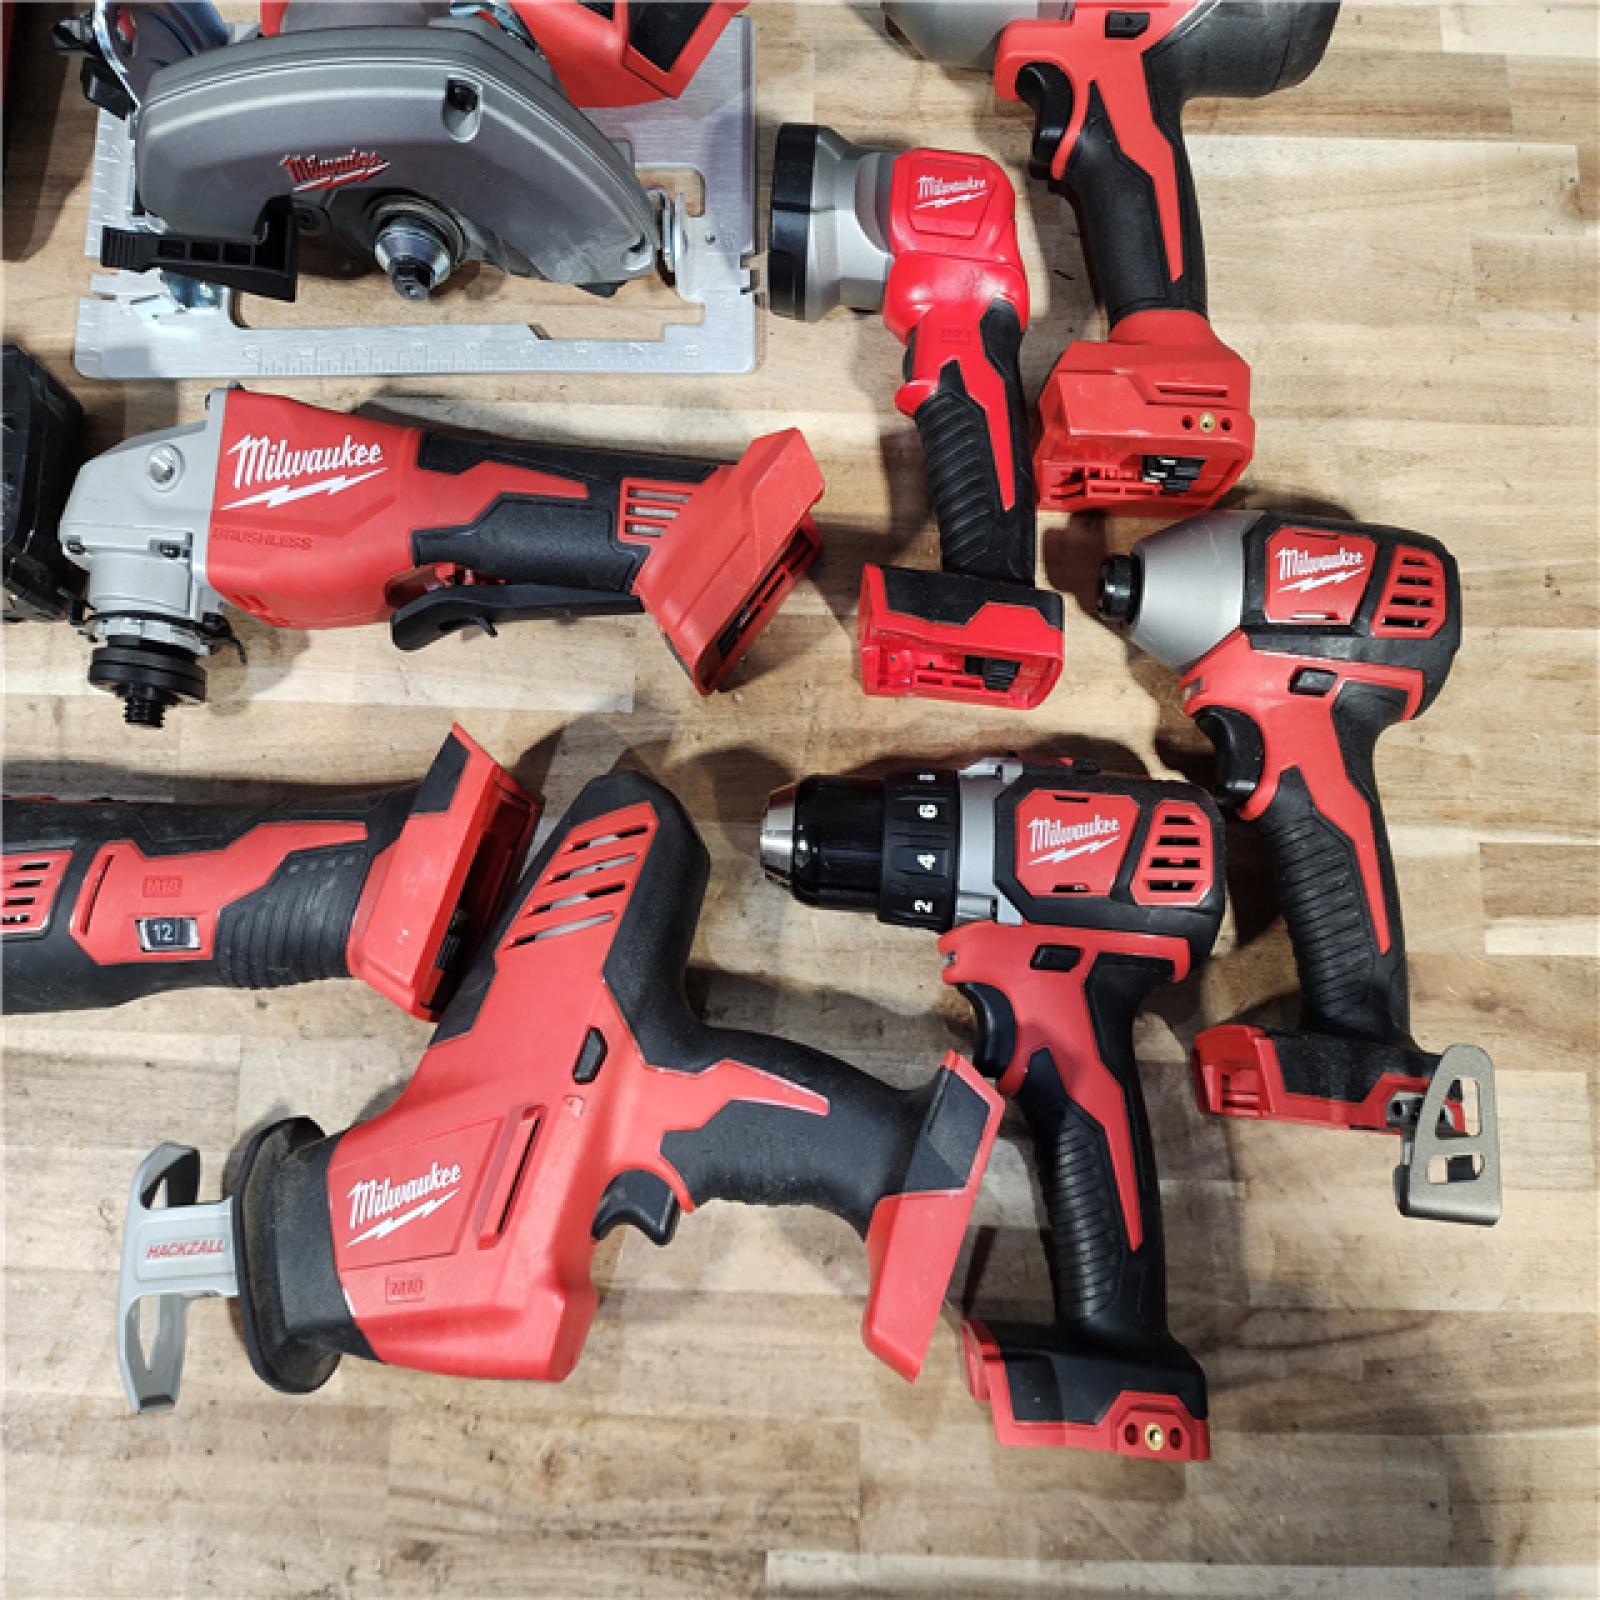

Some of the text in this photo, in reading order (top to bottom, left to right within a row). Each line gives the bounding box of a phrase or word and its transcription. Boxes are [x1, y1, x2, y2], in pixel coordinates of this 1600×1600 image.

[915, 174, 986, 199] Milwaukee
[227, 434, 384, 489] Milwaukee
[1274, 546, 1365, 581] Milwaukee
[1027, 812, 1120, 853] Milwaukee
[917, 853, 936, 870] 4
[914, 899, 934, 914] 2
[152, 922, 174, 942] 12
[347, 1161, 463, 1230] Milwaukee
[146, 1238, 224, 1257] HACKZALL
